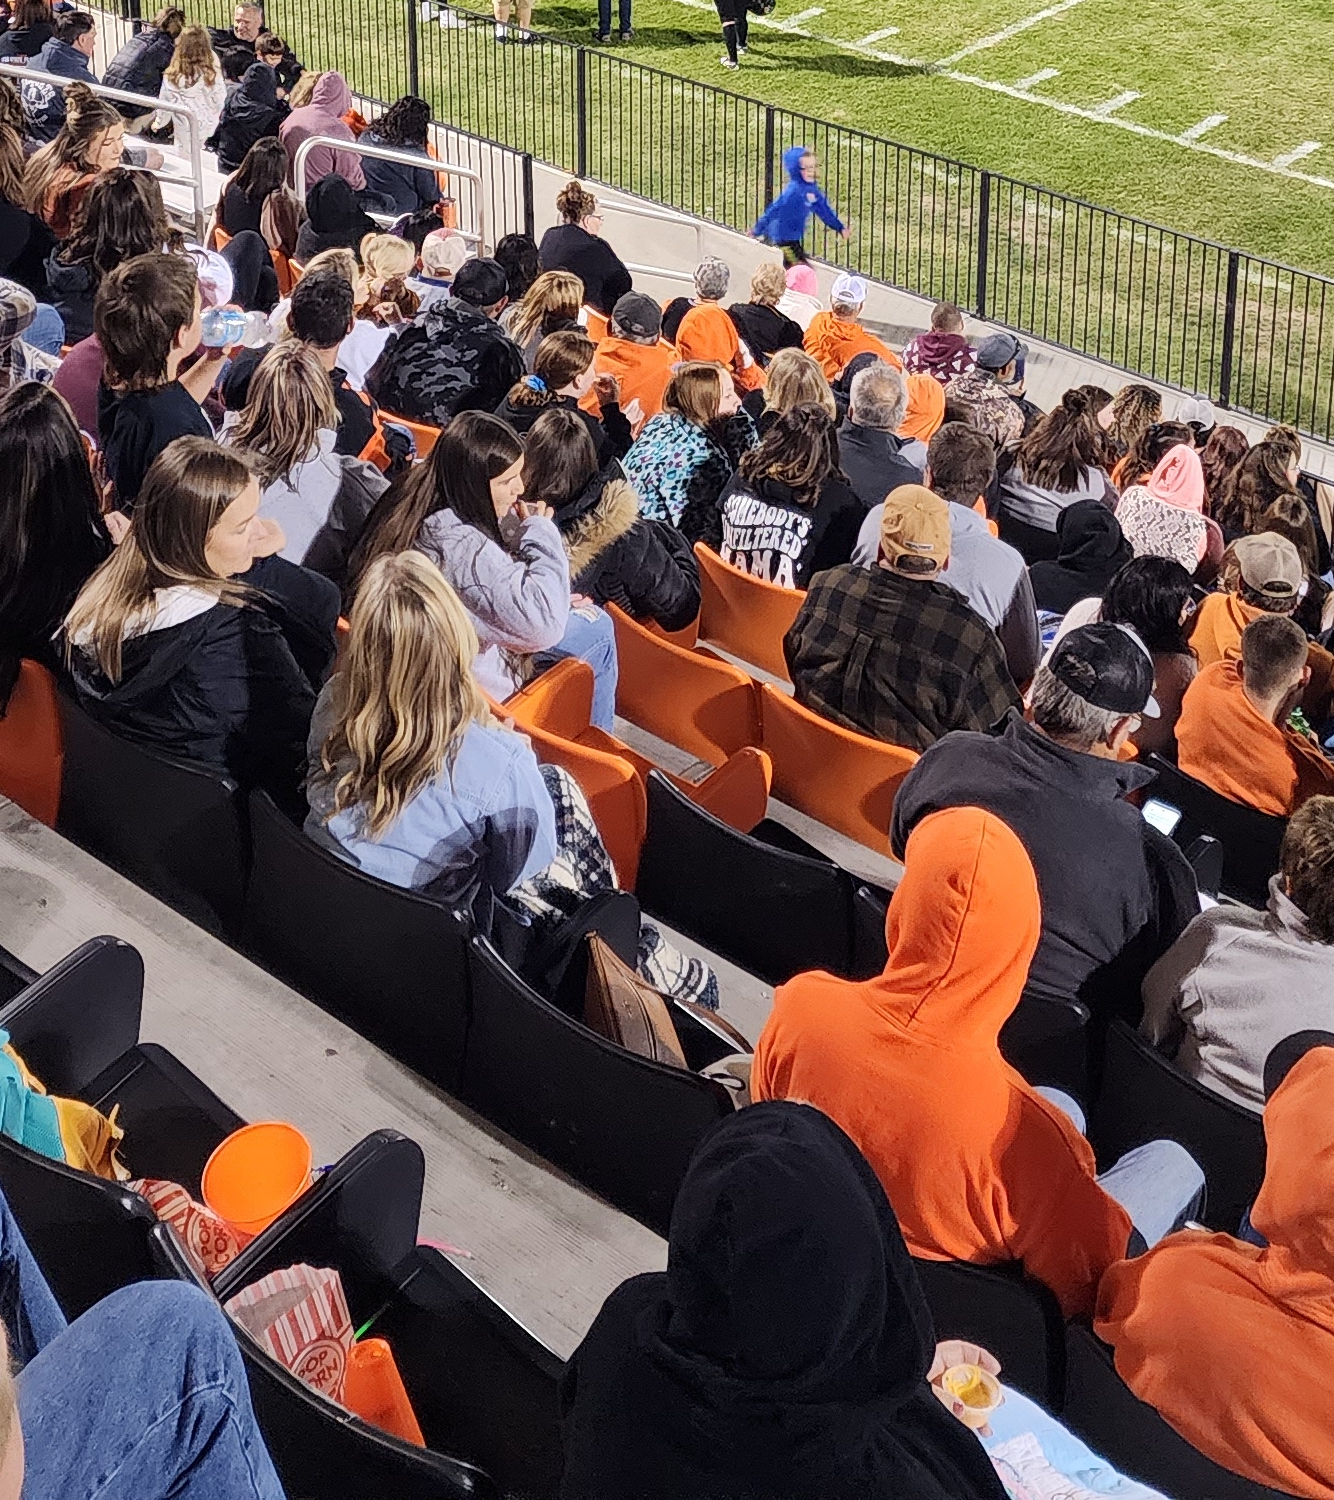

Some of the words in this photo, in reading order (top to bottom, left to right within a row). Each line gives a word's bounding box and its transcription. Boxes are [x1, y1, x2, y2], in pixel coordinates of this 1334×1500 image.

[723, 493, 811, 539] SOMEBODY'S
[198, 1217, 210, 1257] POP
[308, 1357, 339, 1388] ORN
